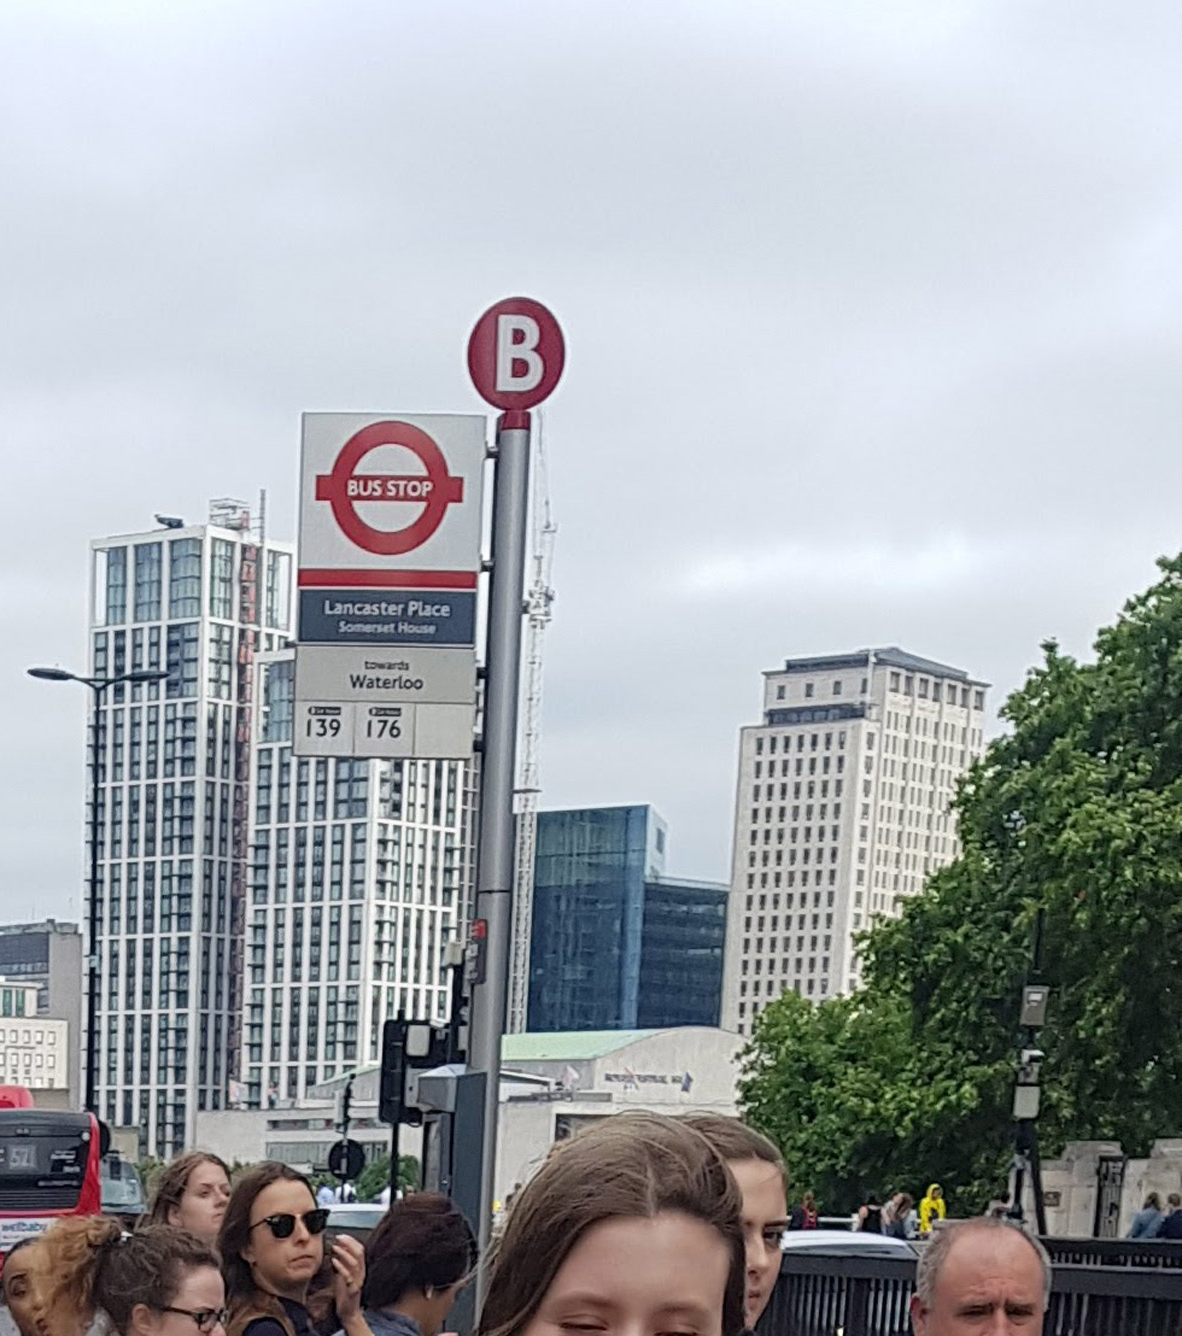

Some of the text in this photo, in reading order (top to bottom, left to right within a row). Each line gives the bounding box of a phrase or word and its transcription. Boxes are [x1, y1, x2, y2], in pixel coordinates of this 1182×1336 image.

[495, 314, 544, 392] B
[346, 479, 434, 497] BUS STOP
[324, 600, 451, 617] Lancaster Place
[338, 620, 437, 635] Somerset House
[364, 660, 410, 671] towards
[349, 674, 424, 690] Waterloo
[306, 718, 341, 738] 139
[366, 719, 402, 739] 176
